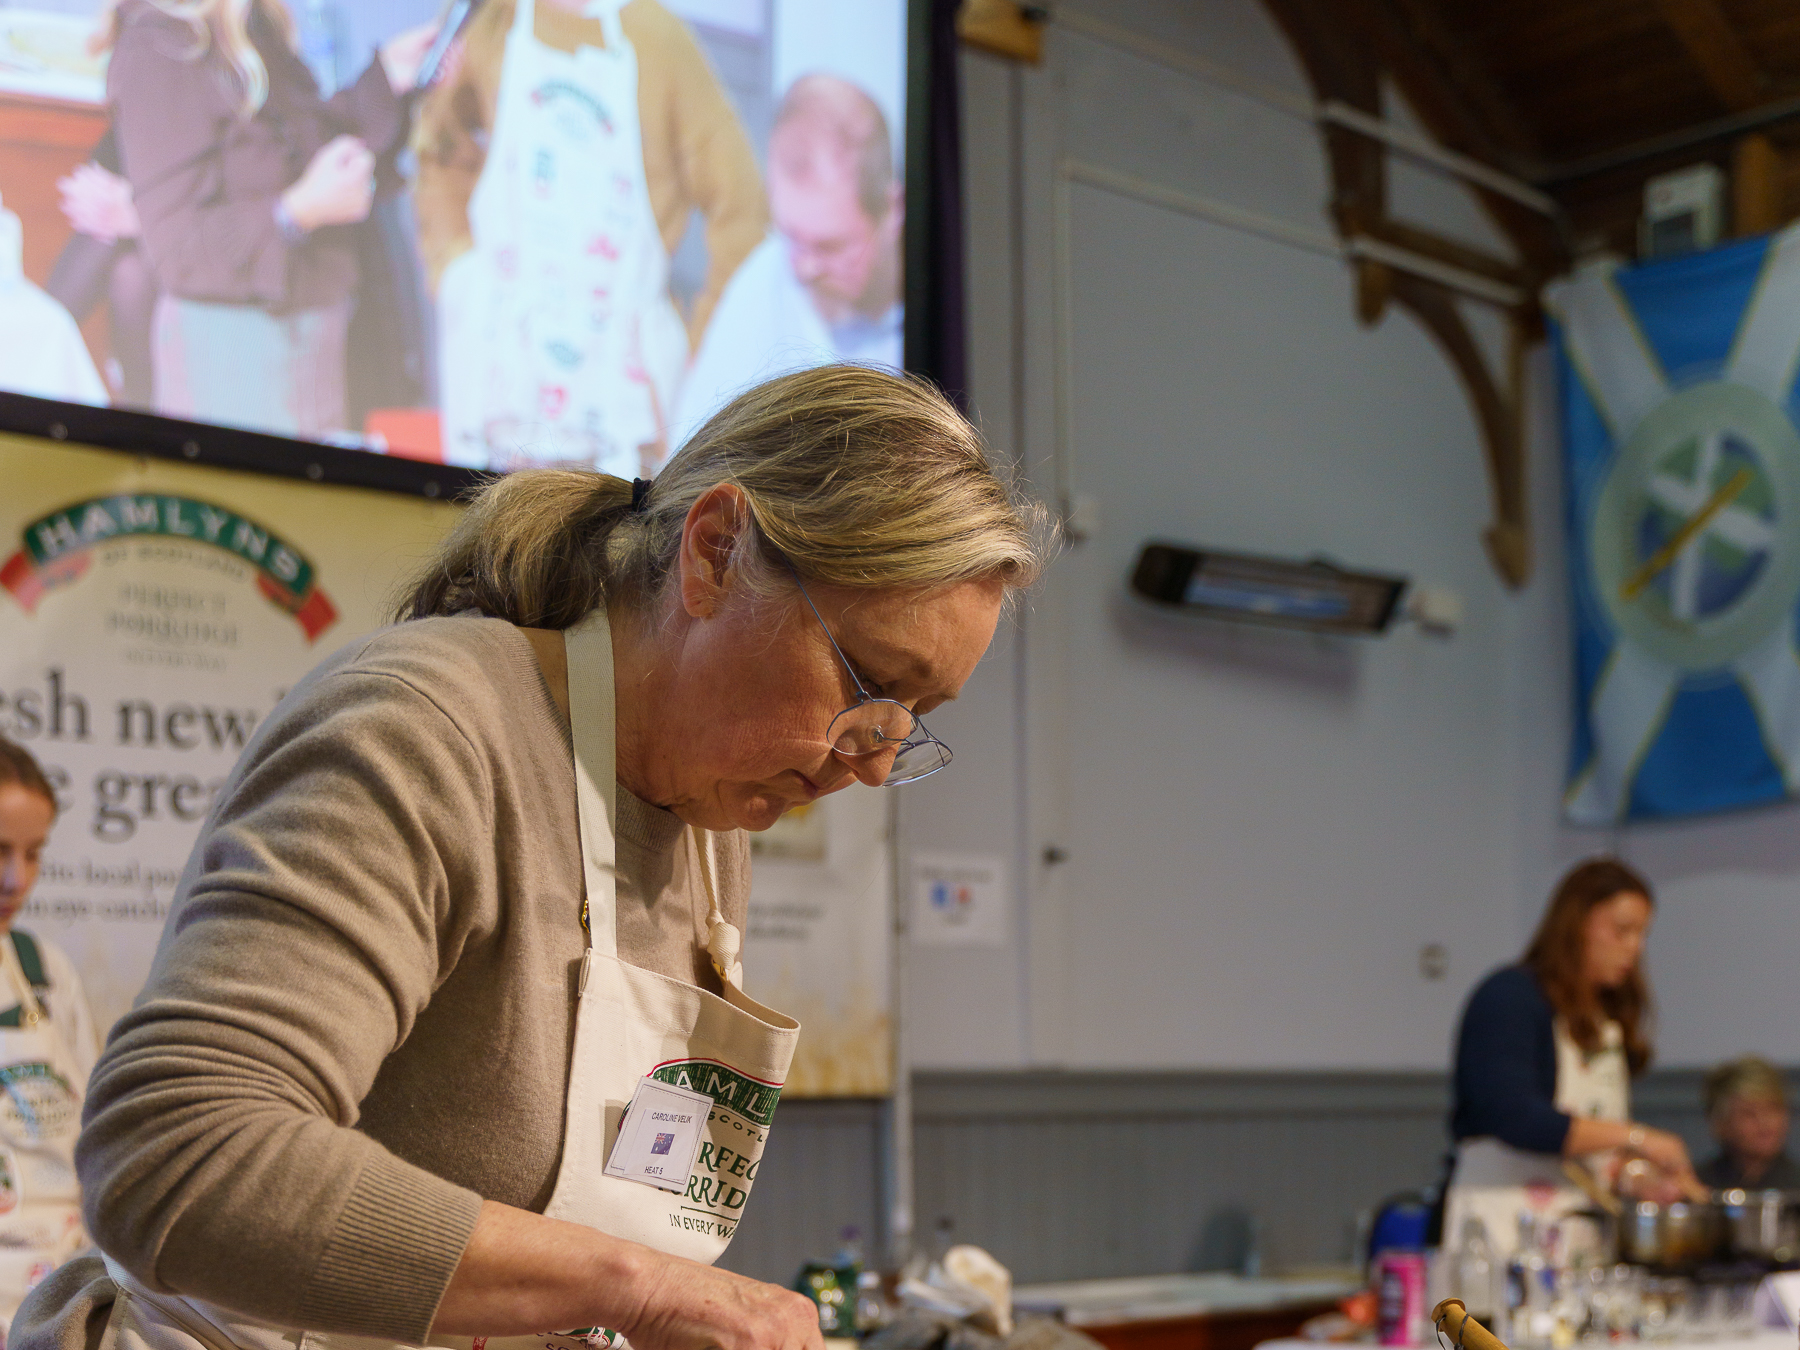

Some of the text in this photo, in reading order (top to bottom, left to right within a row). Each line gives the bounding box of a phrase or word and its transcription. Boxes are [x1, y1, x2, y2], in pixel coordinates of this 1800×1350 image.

[40, 498, 300, 583] HAMLYNS
[117, 699, 257, 750] new
[657, 1070, 768, 1119] AML
[651, 1111, 678, 1123] CAROLINE
[708, 1111, 766, 1143] SCOTL
[644, 1166, 659, 1175] HEAT
[658, 1174, 747, 1209] RRID
[669, 1213, 682, 1228] IN
[683, 1216, 715, 1236] EVERY
